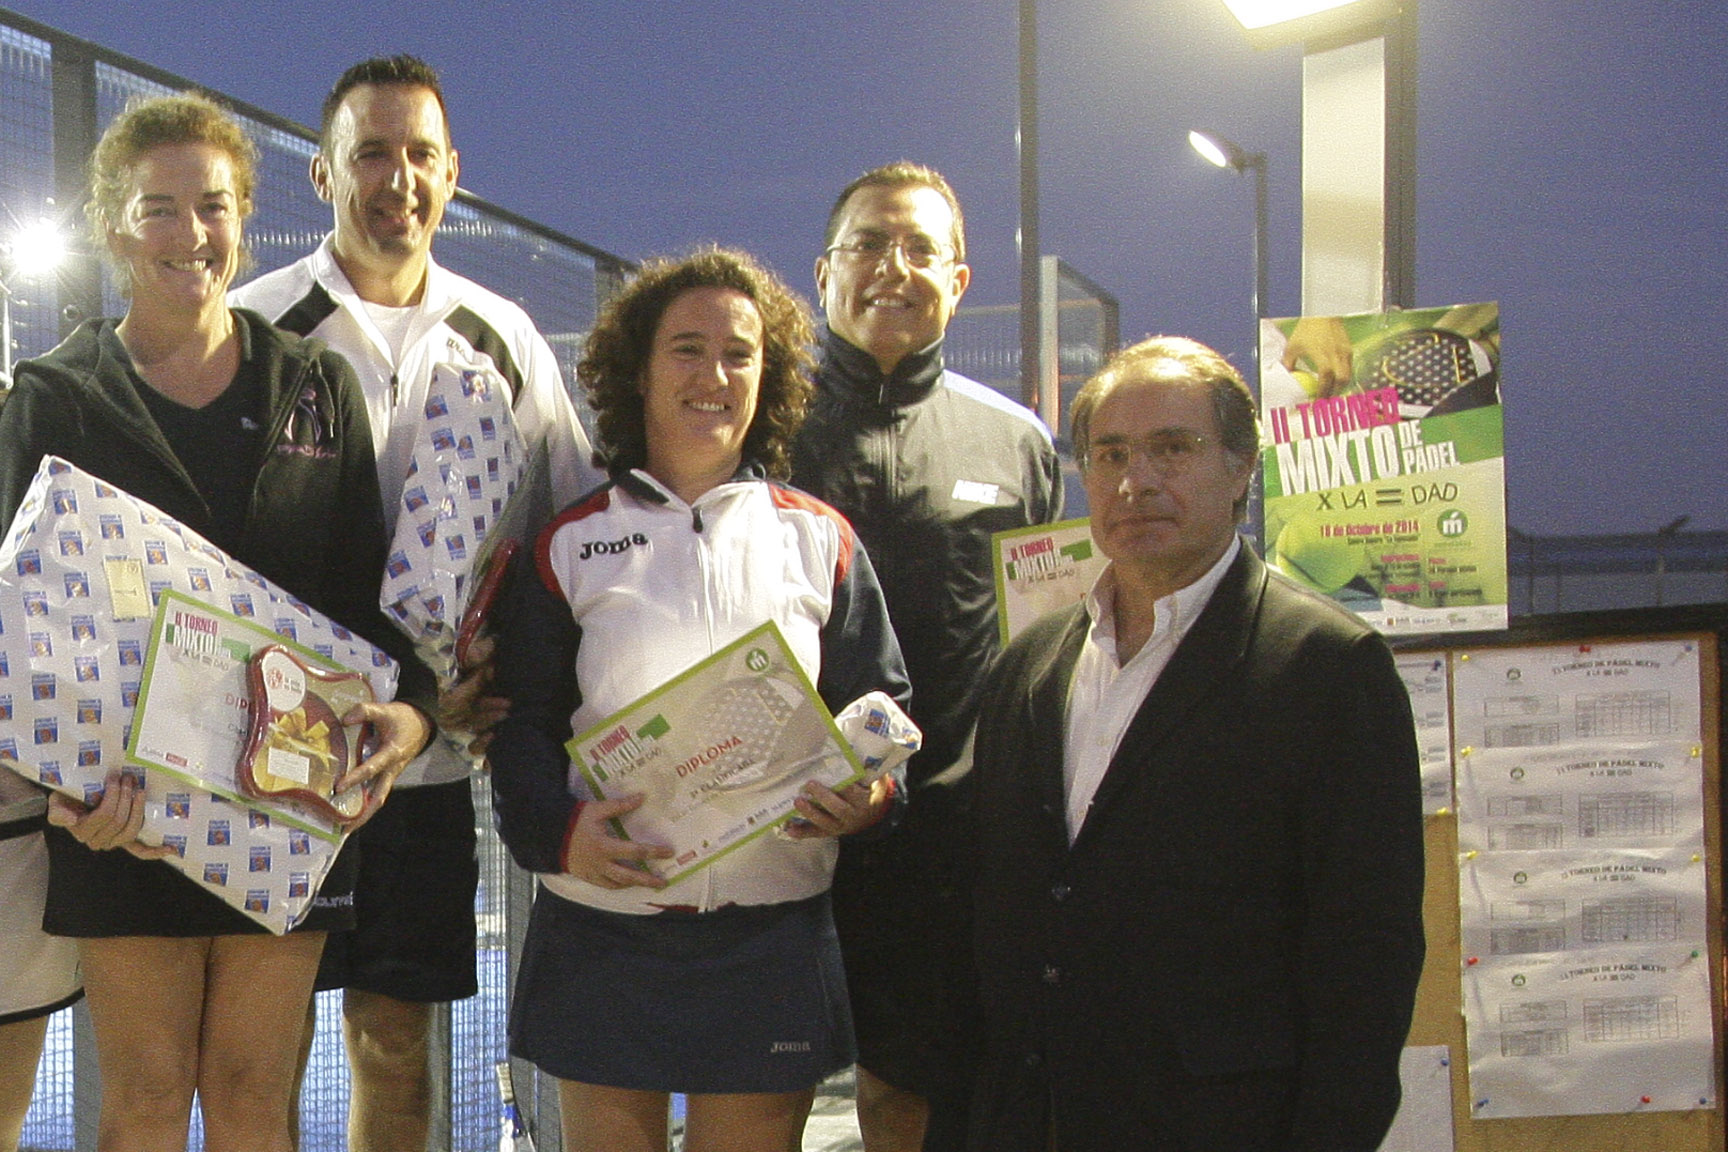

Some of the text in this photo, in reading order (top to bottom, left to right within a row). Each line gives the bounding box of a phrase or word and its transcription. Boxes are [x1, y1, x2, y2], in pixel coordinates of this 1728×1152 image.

[1270, 386, 1402, 444] II TORNEO
[1276, 419, 1423, 496] MIXTO DE
[1317, 491, 1333, 510] X
[1341, 489, 1367, 509] LA
[1411, 482, 1459, 505] DAD
[185, 613, 218, 635] TORNEO
[675, 736, 742, 778] DIPLOMA
